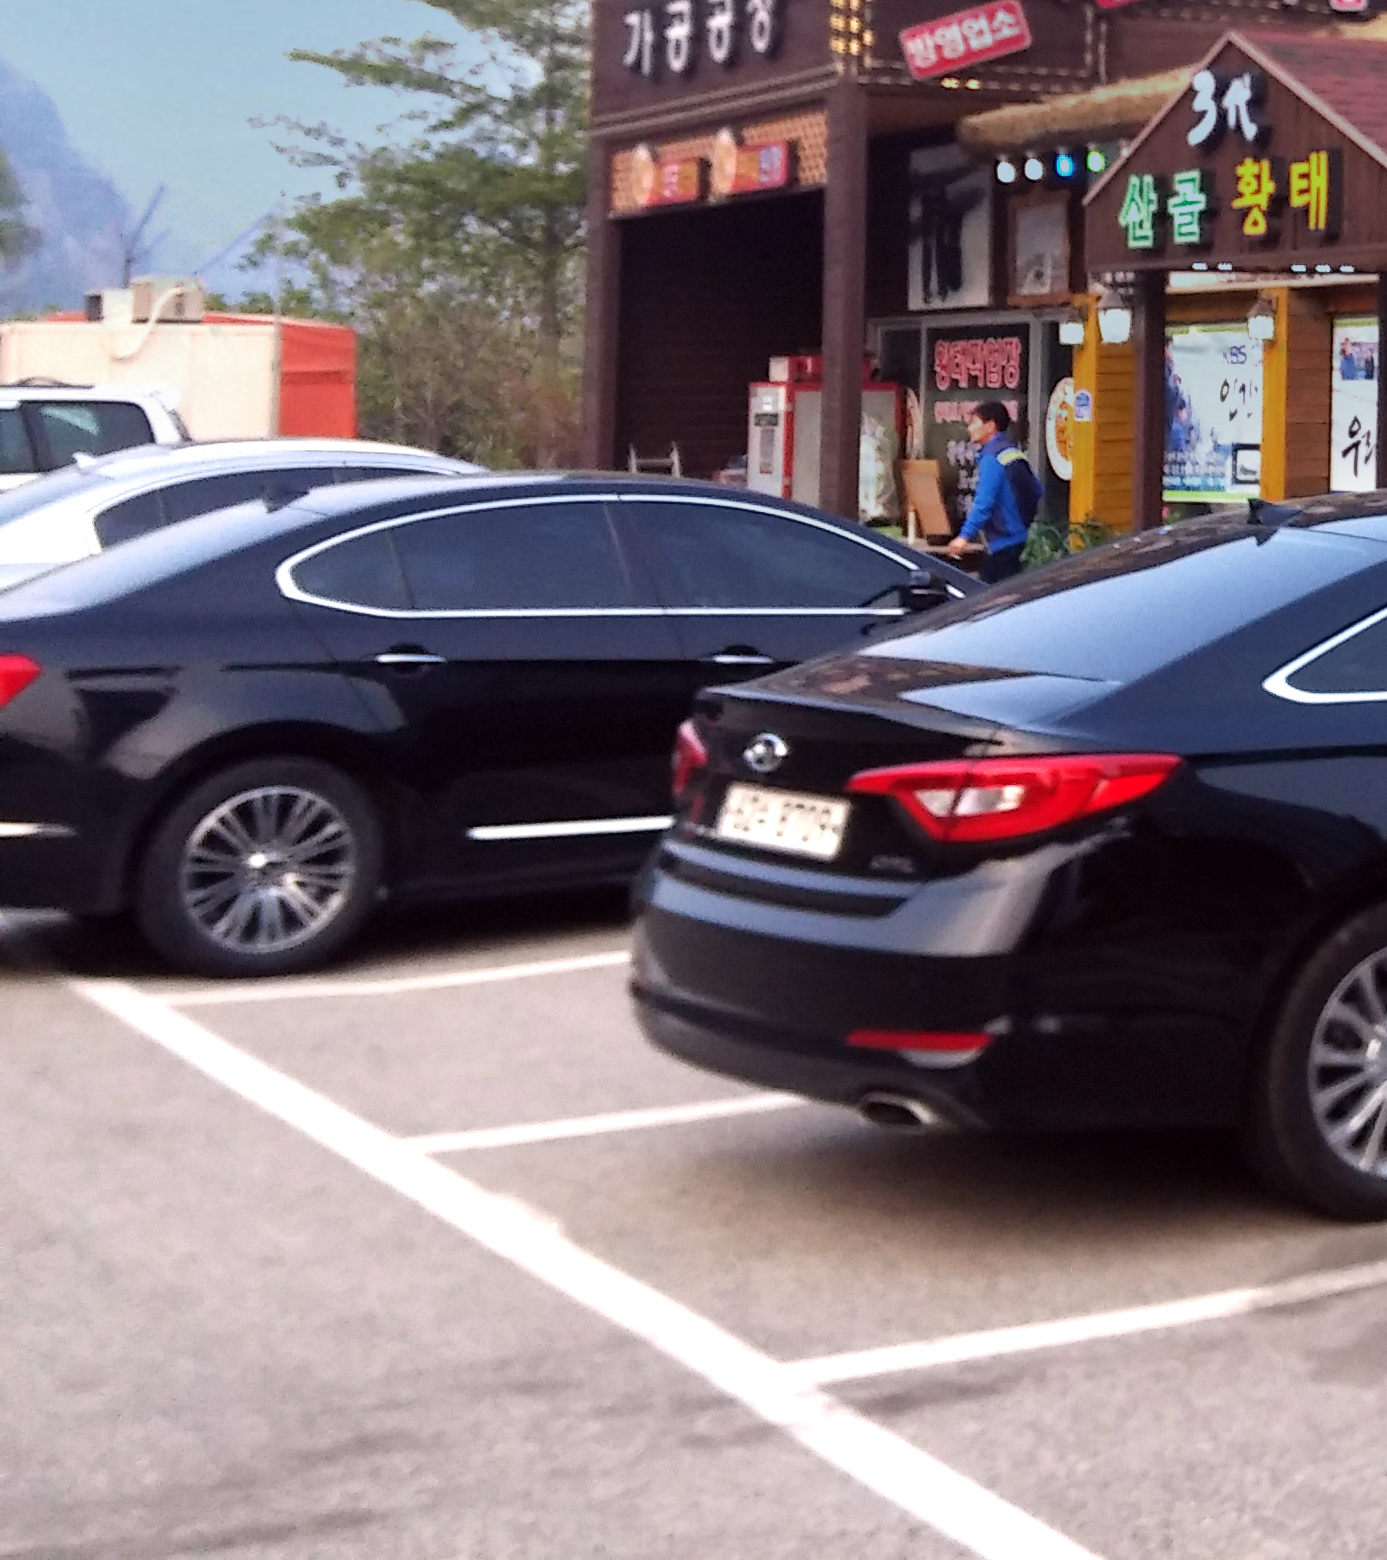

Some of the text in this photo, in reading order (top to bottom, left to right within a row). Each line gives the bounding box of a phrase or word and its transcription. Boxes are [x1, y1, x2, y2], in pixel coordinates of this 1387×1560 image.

[1187, 70, 1257, 145] 3代
[1118, 150, 1329, 249] 산골 황태
